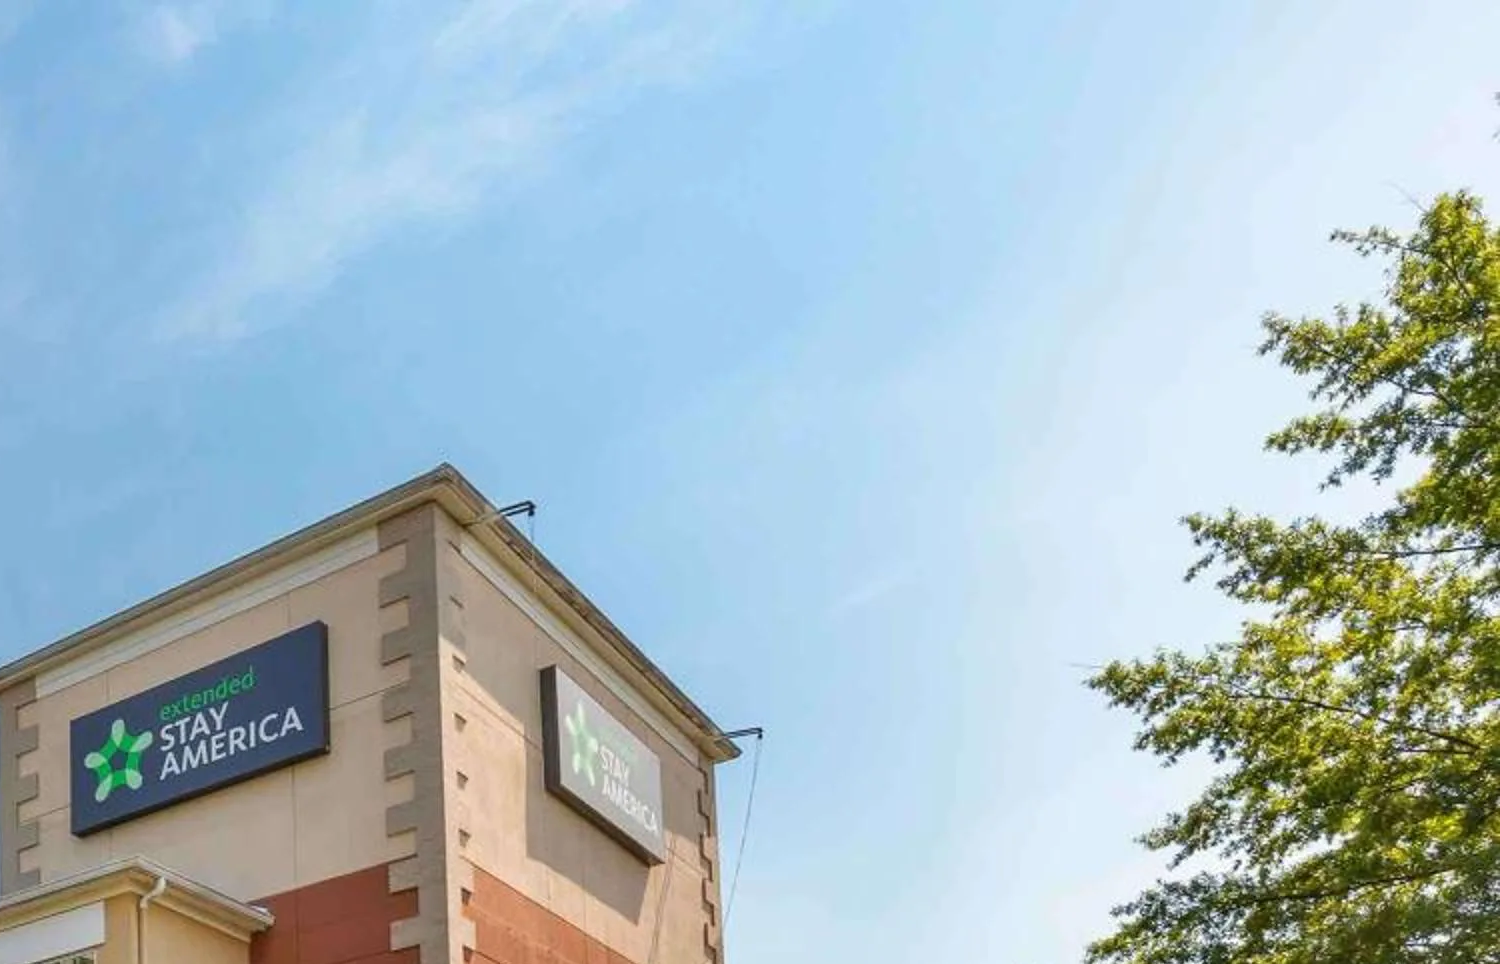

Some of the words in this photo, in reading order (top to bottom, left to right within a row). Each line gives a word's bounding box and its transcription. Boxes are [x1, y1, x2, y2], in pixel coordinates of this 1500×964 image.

[159, 666, 255, 720] extended
[159, 702, 229, 751] STAY
[159, 707, 304, 780] AMERICA
[601, 745, 630, 788] STAY
